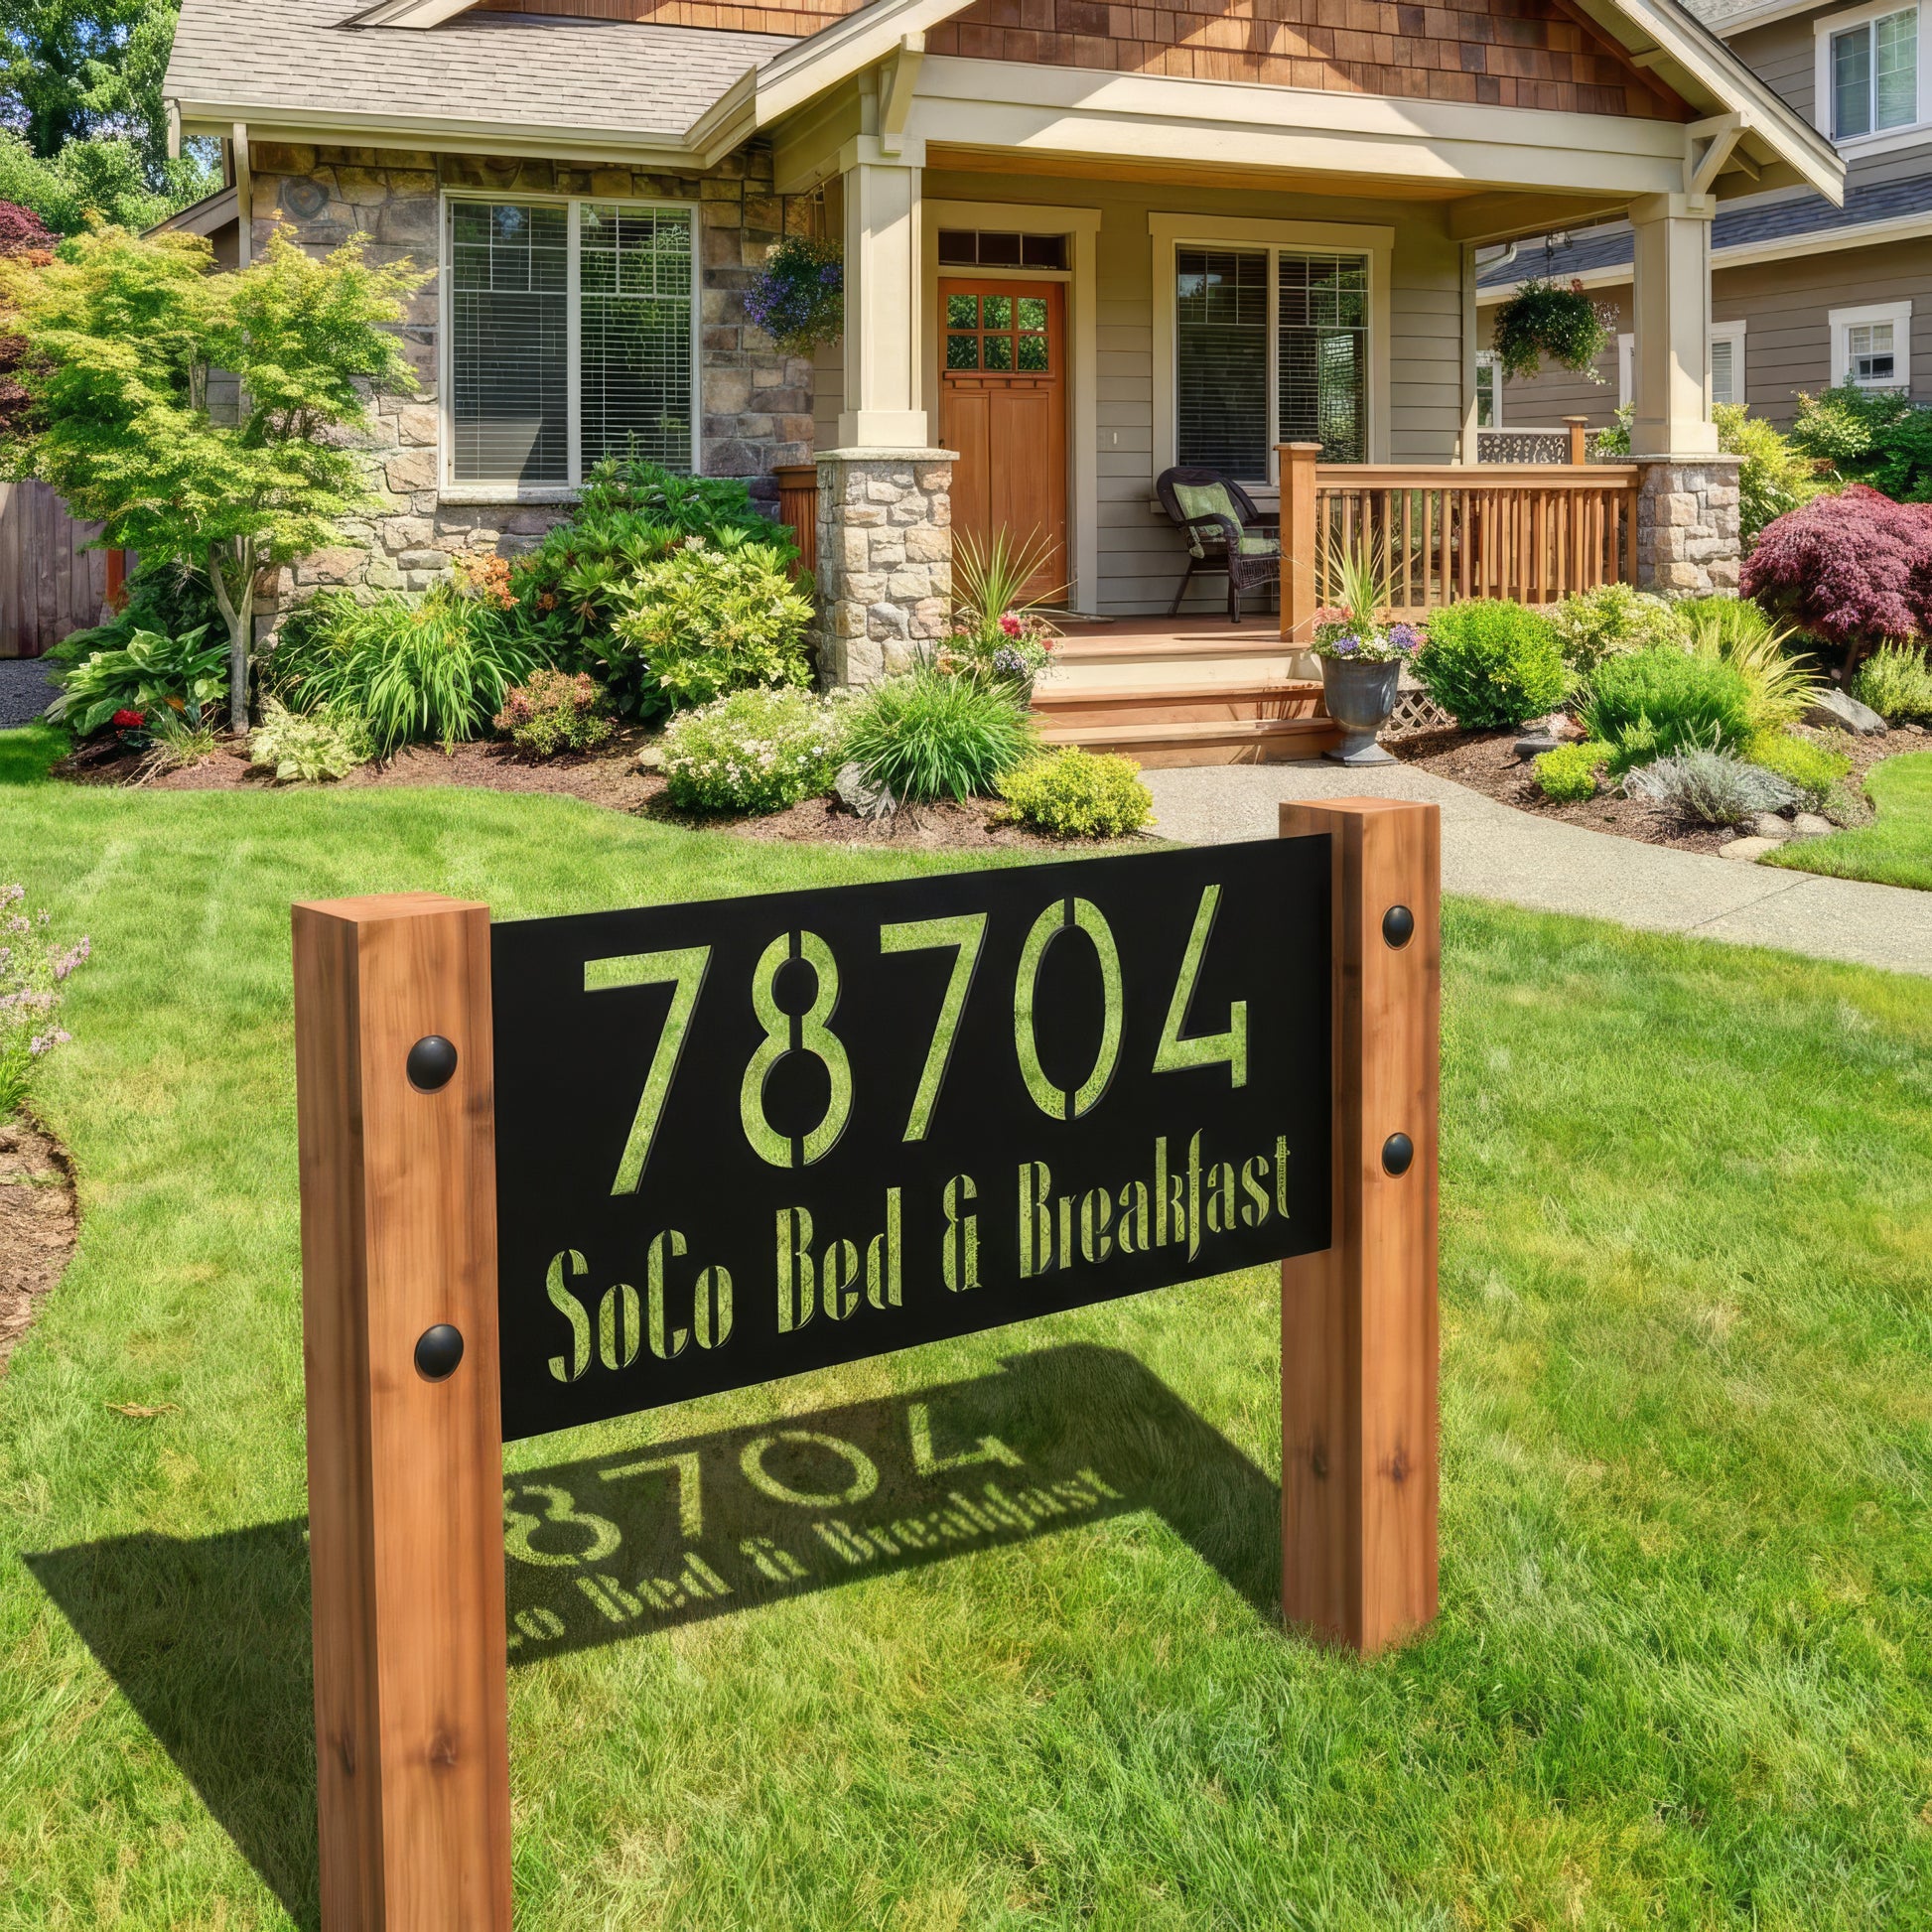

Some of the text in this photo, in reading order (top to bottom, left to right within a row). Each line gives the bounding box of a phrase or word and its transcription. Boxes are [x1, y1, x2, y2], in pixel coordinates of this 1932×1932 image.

[583, 884, 1249, 1196] 78704
[545, 1127, 1292, 1383] SoCo Bed & Breakfast
